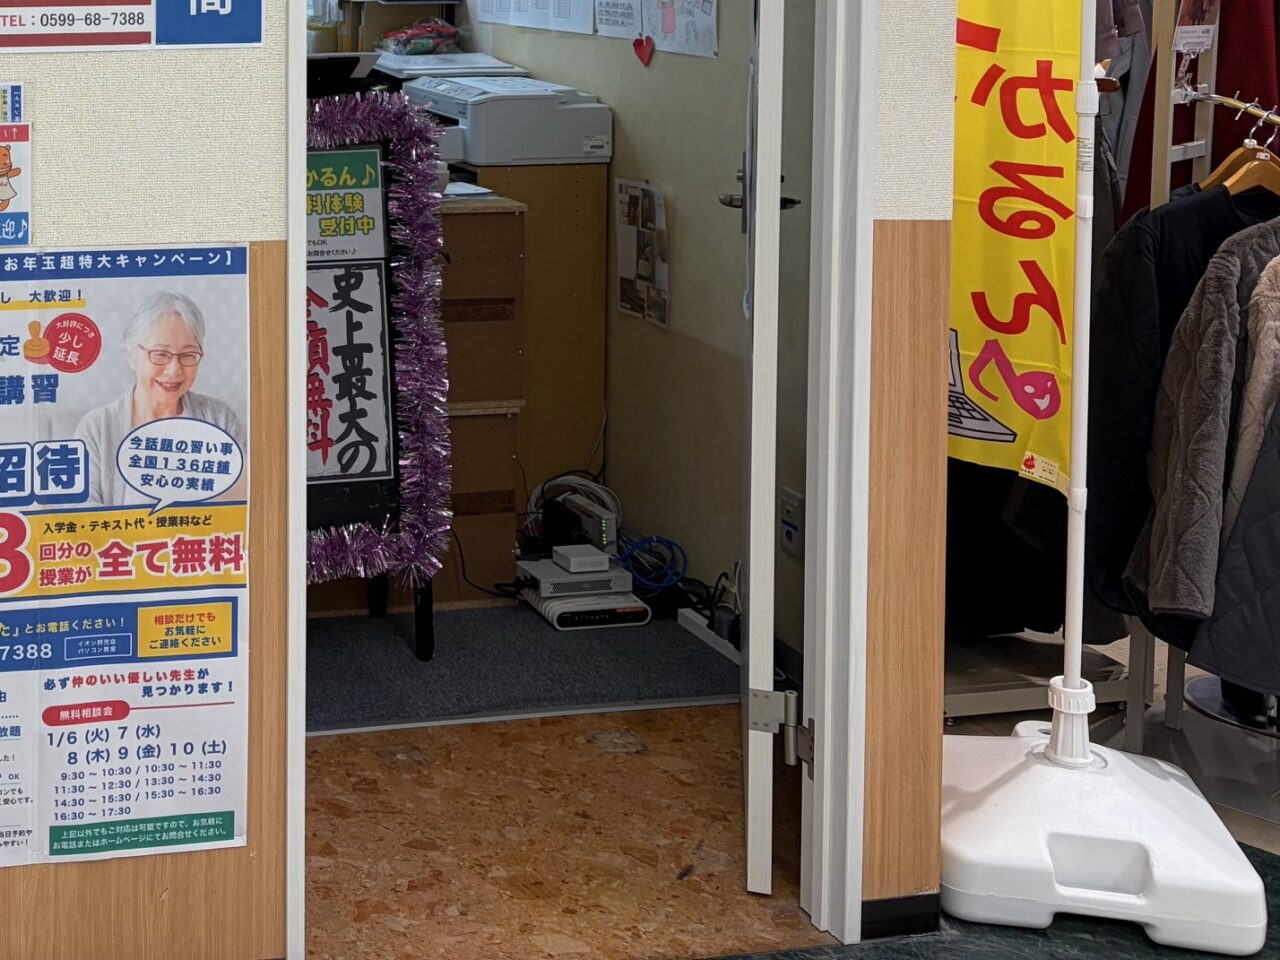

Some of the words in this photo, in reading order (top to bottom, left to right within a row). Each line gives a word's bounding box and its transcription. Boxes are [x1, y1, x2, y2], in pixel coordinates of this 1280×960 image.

[40, 12, 145, 27] 0599-68-7388
[319, 215, 375, 237] 受付中
[57, 331, 84, 349] 少し
[52, 347, 81, 366] 延長
[330, 265, 379, 475] 史上最大の
[129, 434, 233, 457] 今話題の習い事
[128, 454, 231, 476] 全国136店舗
[140, 473, 215, 492] 安心の実績
[39, 540, 92, 562] 回分の
[98, 533, 244, 578] 全て無料
[39, 565, 93, 587] 授業が
[154, 612, 215, 625] 相談だけでも
[165, 626, 205, 636] お気軽に
[149, 636, 221, 649] ご連絡ください
[44, 668, 209, 691] 必ず仲のいい優しい先生が
[59, 707, 113, 721] 無料相談会
[47, 732, 77, 747] 1/6
[118, 726, 128, 739] 7
[67, 752, 77, 765] 8
[118, 746, 129, 760] 9
